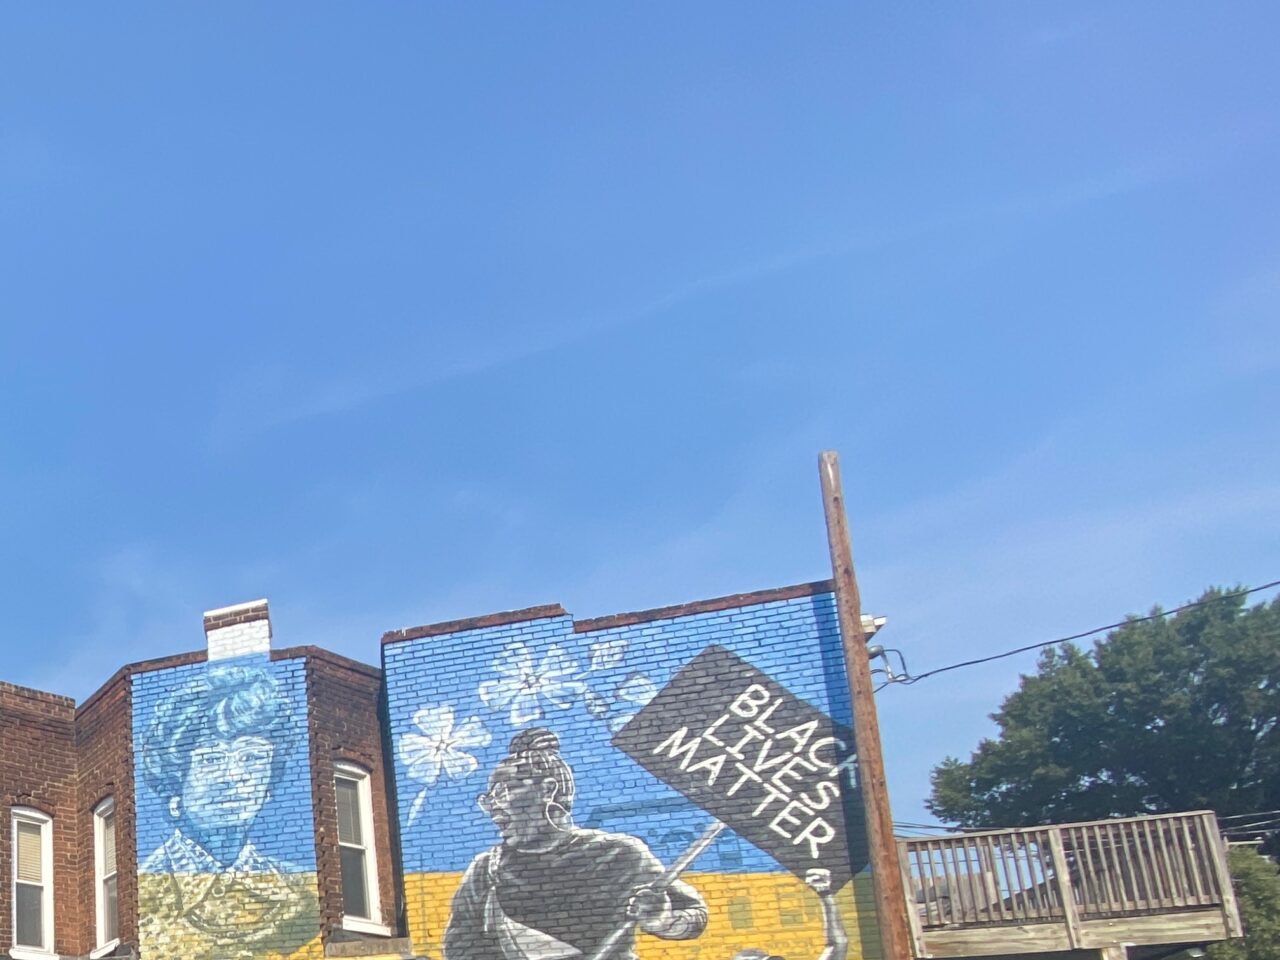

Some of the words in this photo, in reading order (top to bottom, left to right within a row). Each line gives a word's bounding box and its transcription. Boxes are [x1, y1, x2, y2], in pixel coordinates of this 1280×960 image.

[701, 713, 840, 811] LIVES
[730, 683, 858, 789] BLACK
[653, 726, 836, 859] MATTER
